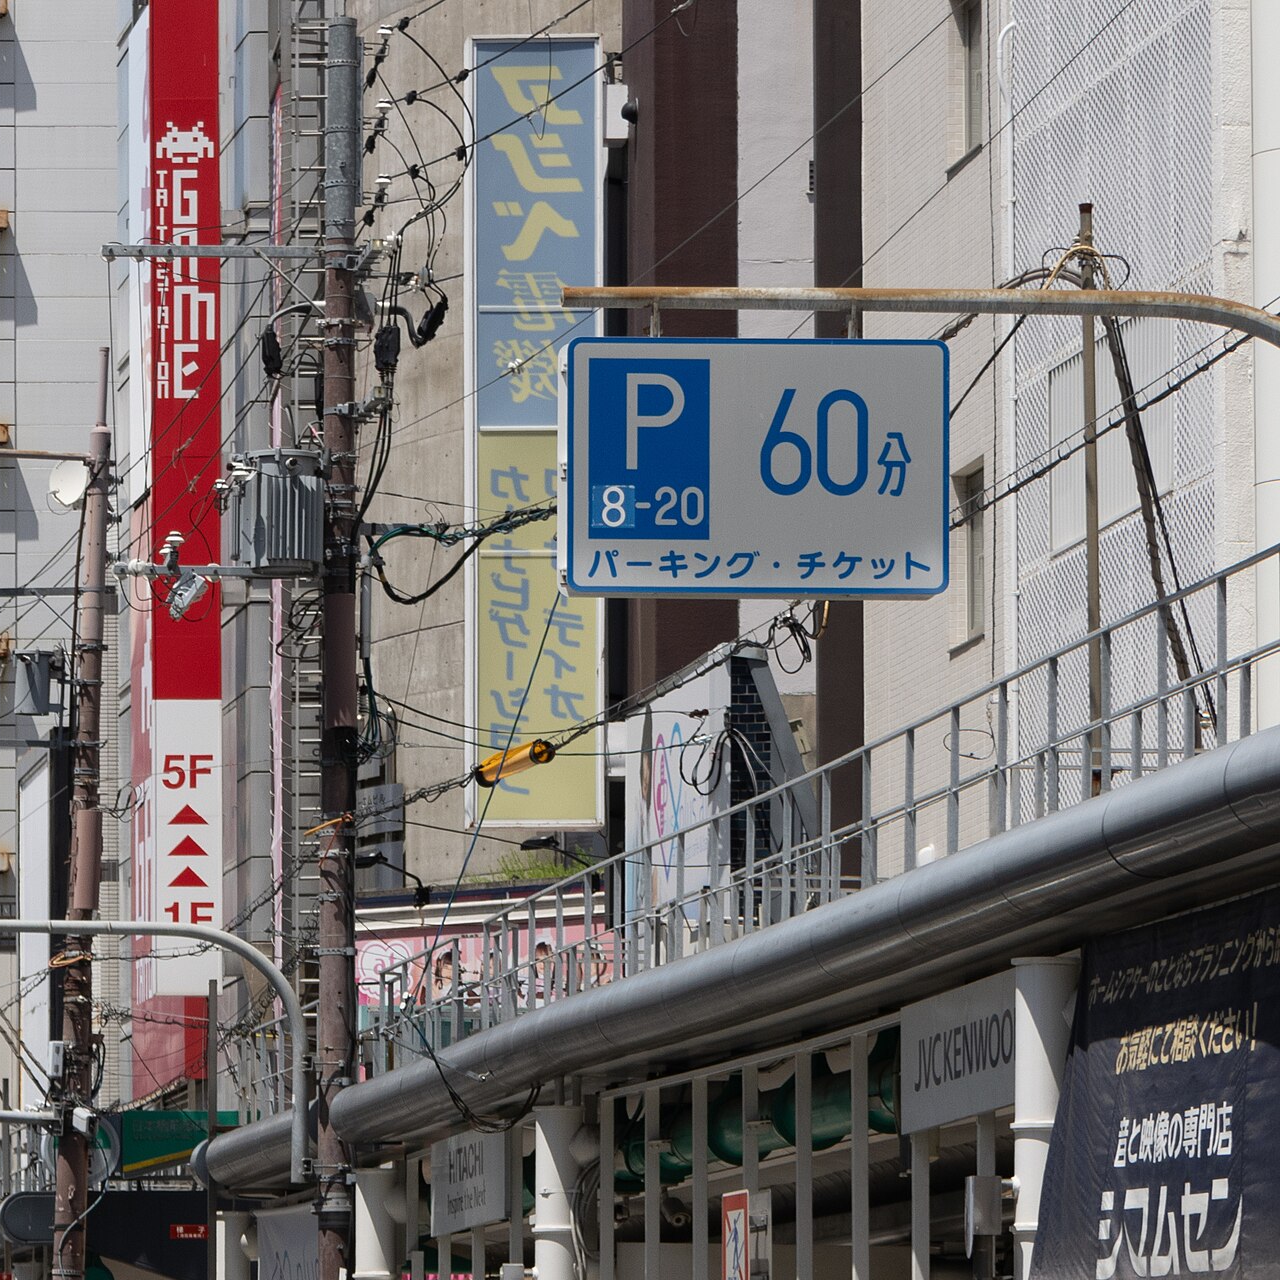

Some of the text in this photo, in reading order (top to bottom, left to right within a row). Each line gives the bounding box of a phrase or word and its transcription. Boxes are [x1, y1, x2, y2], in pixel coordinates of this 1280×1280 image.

[173, 170, 215, 398] GAME
[627, 373, 685, 470] P
[760, 389, 912, 498] 60分
[600, 485, 704, 527] 8-20
[589, 550, 931, 580] パーキング・チケット
[162, 754, 214, 789] 5F
[913, 1006, 1016, 1093] JVCKENWOO
[448, 1140, 484, 1185] HITACHI
[1114, 1101, 1234, 1168] 音と映像の専門店
